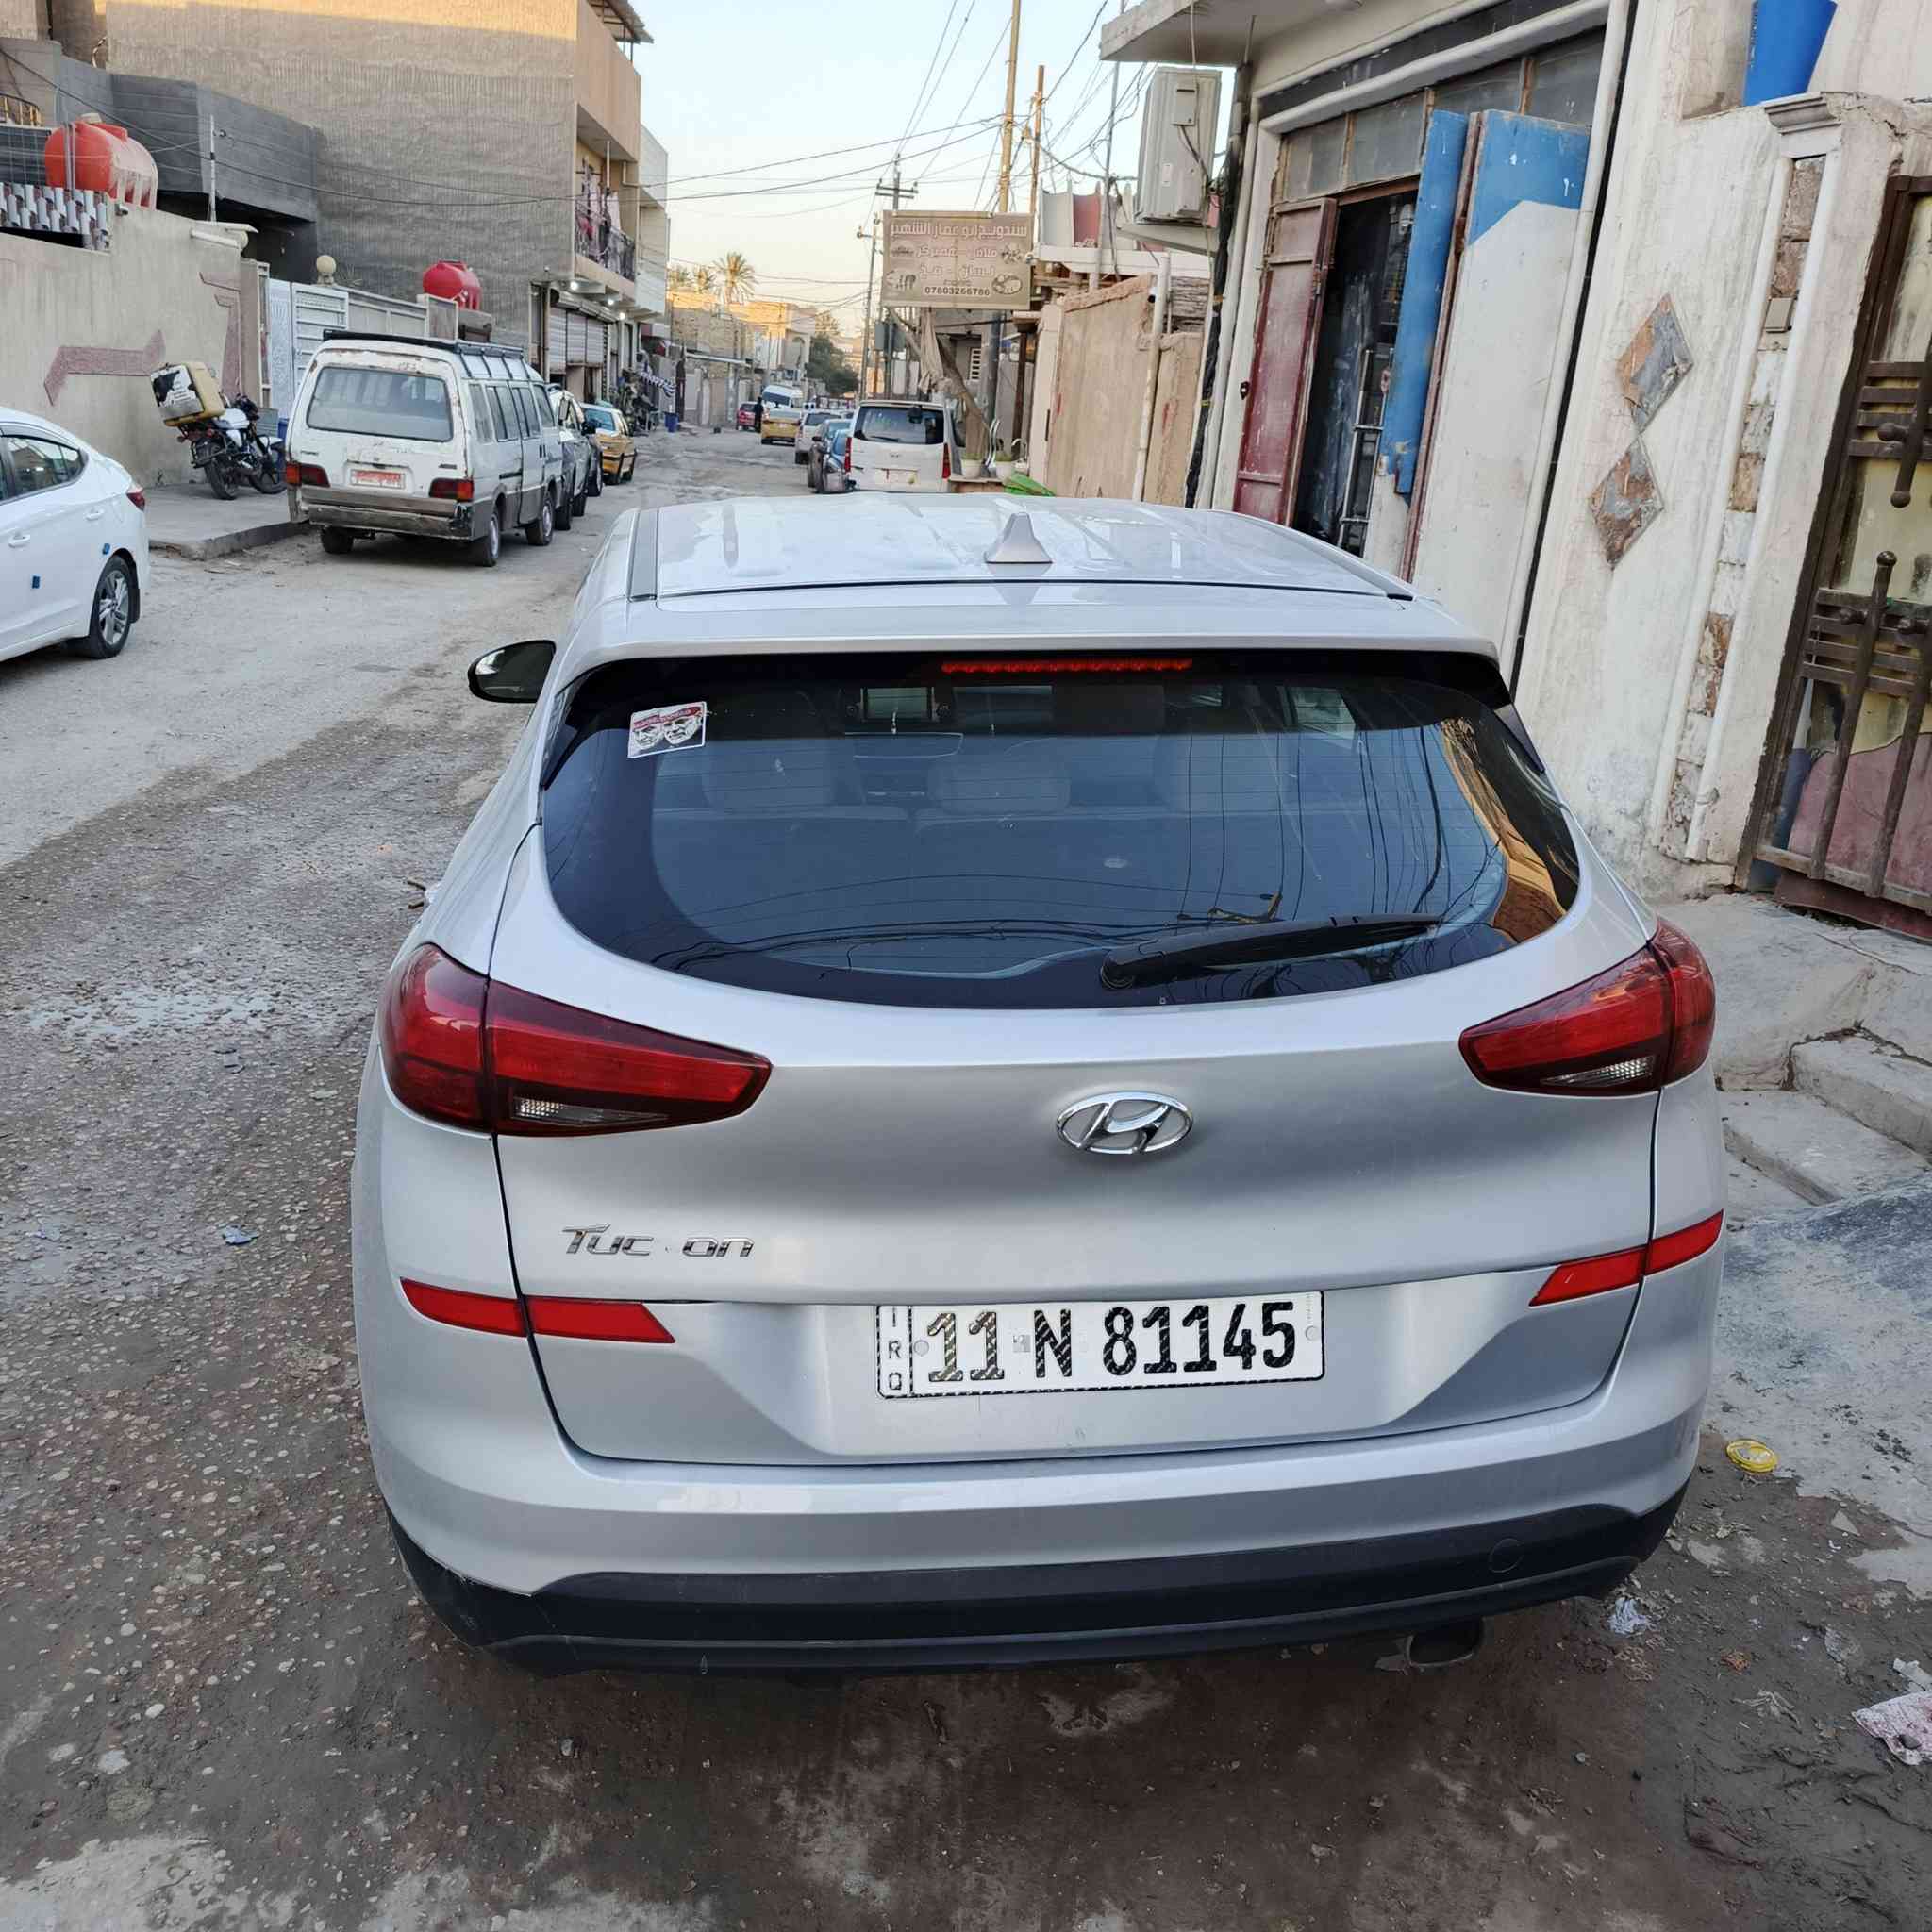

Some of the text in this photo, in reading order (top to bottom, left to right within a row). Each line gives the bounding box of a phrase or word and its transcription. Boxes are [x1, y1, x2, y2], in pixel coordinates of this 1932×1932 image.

[927, 1311, 1005, 1382] 11
[1034, 1308, 1073, 1378] N
[1103, 1302, 1296, 1377] 81145
